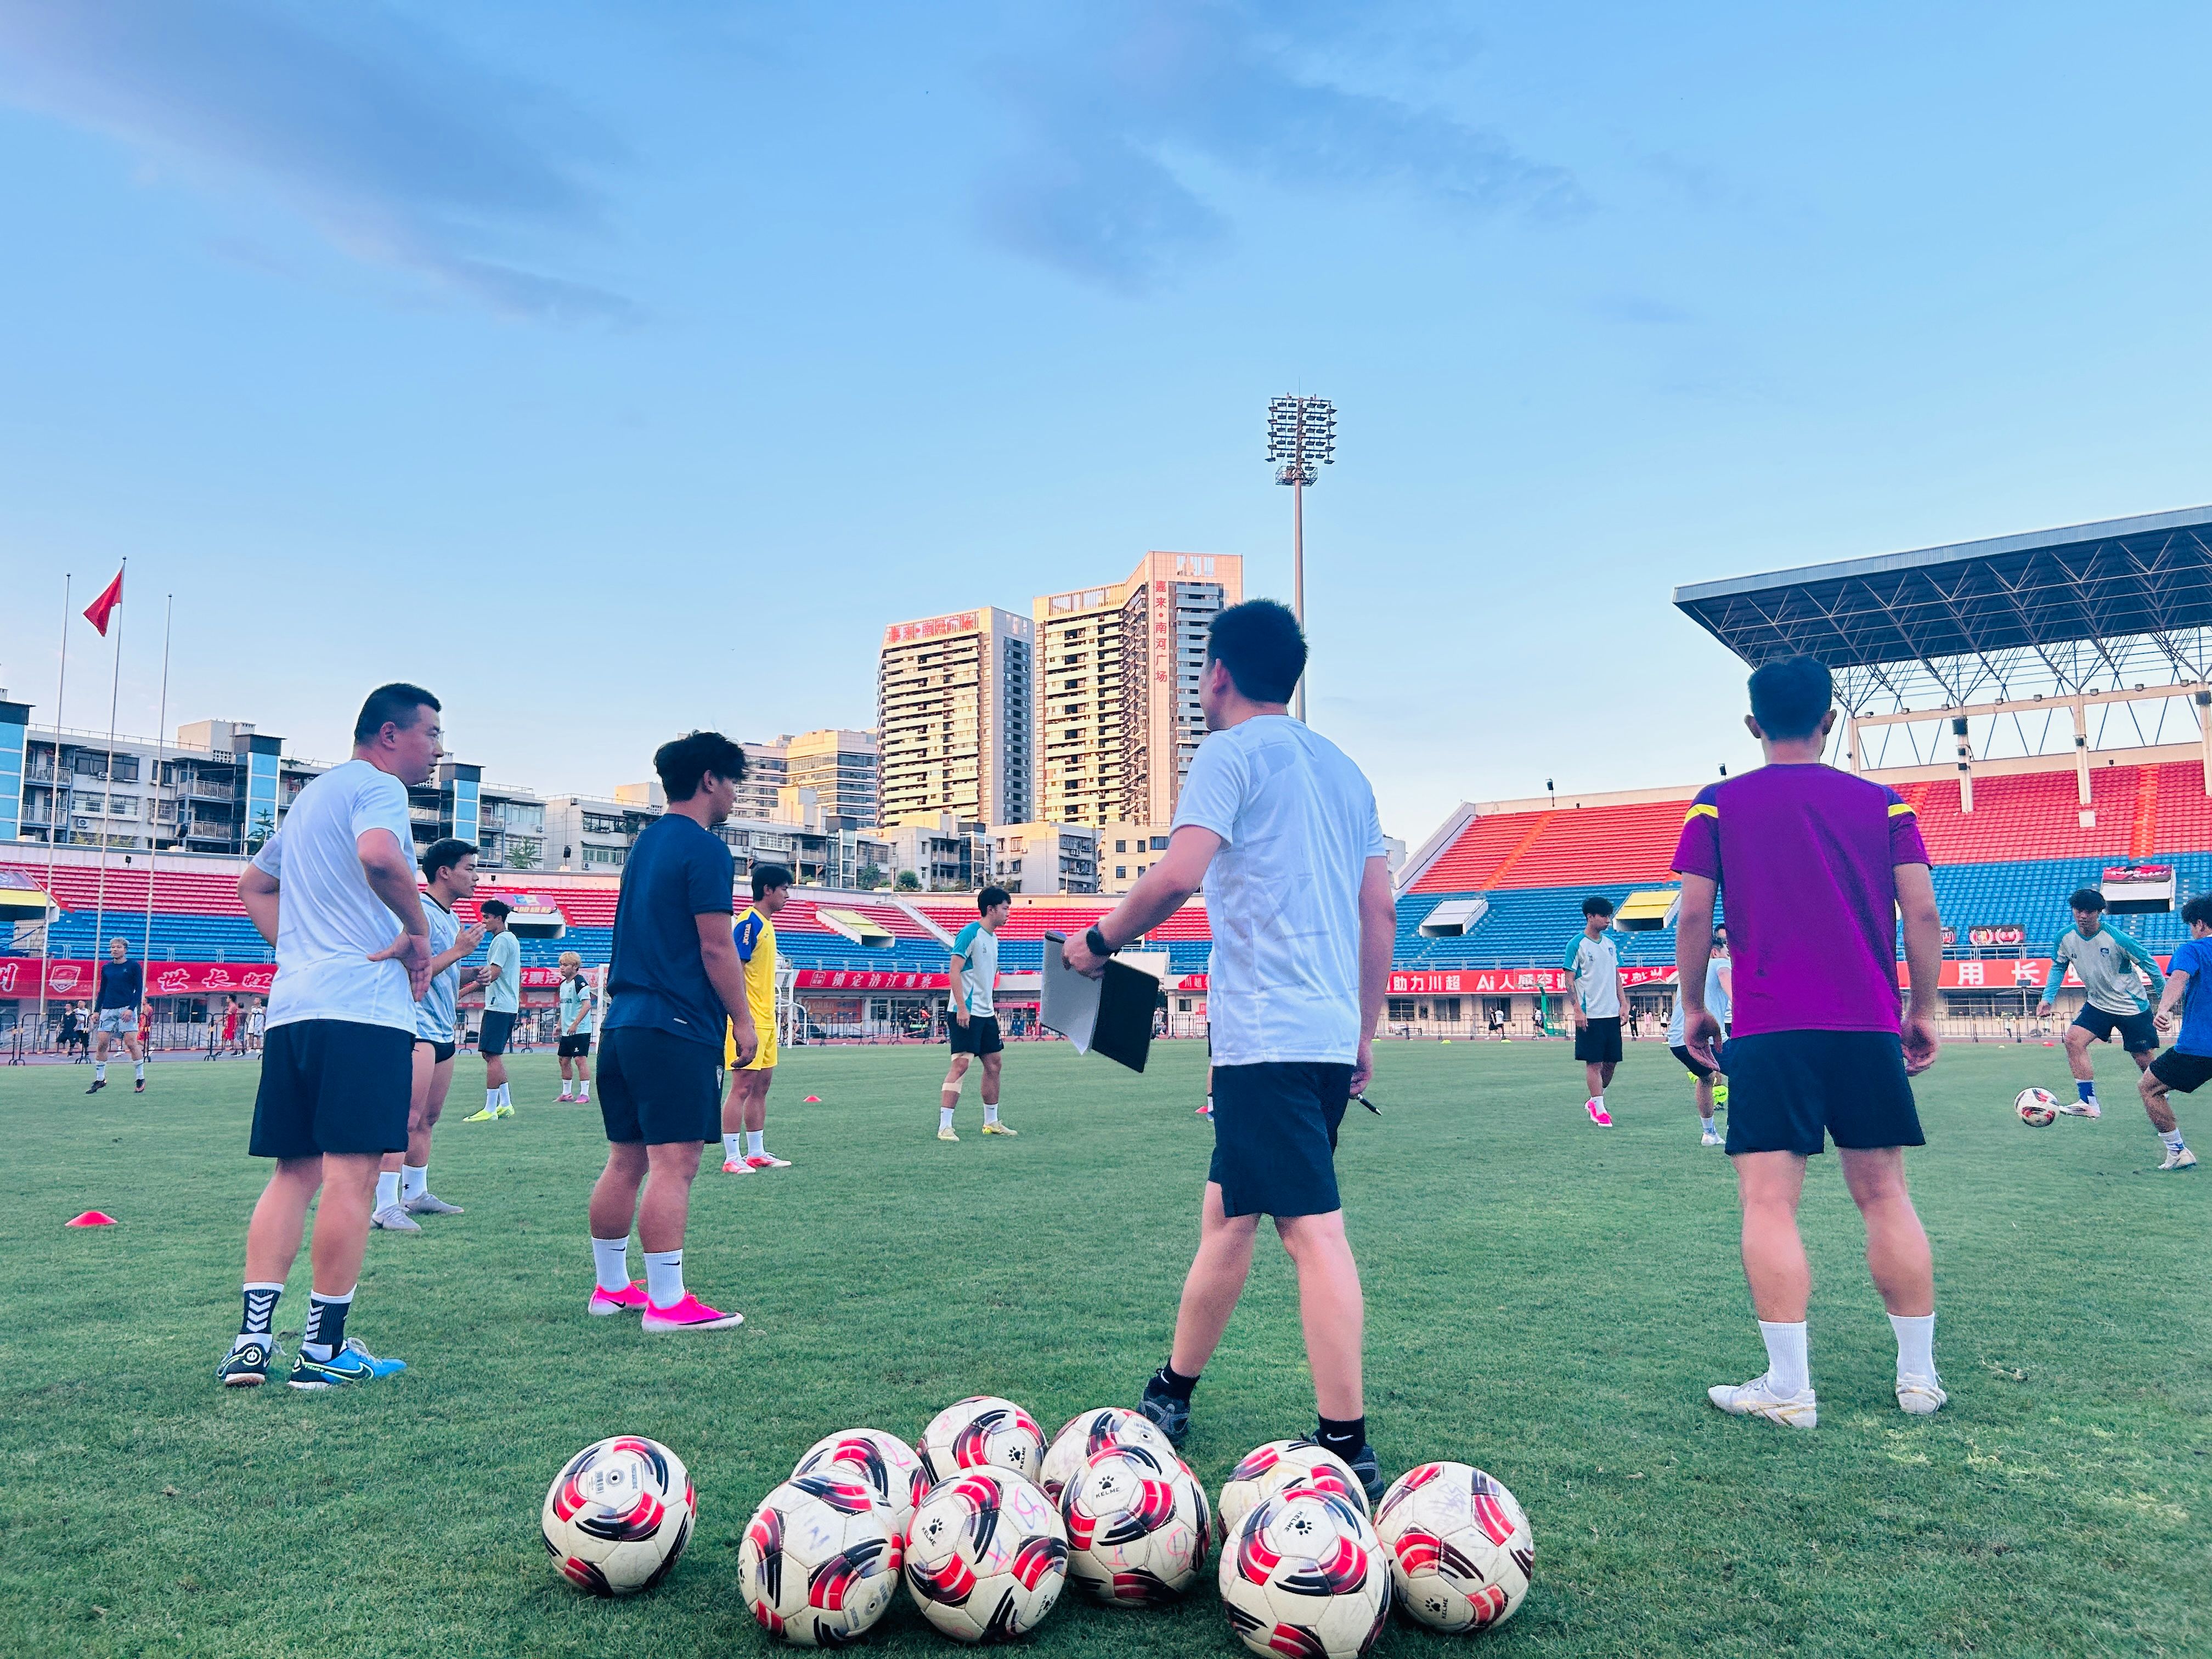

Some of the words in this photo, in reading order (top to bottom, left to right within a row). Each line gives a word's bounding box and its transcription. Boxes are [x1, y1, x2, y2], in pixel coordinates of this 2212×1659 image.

[144, 968, 272, 992] 世长虹
[1184, 977, 1207, 988] 川超
[1387, 975, 1460, 991] 助力川超
[1096, 1487, 1120, 1498] KELME
[1284, 1511, 1304, 1532] KELME
[922, 1526, 936, 1547] KELME
